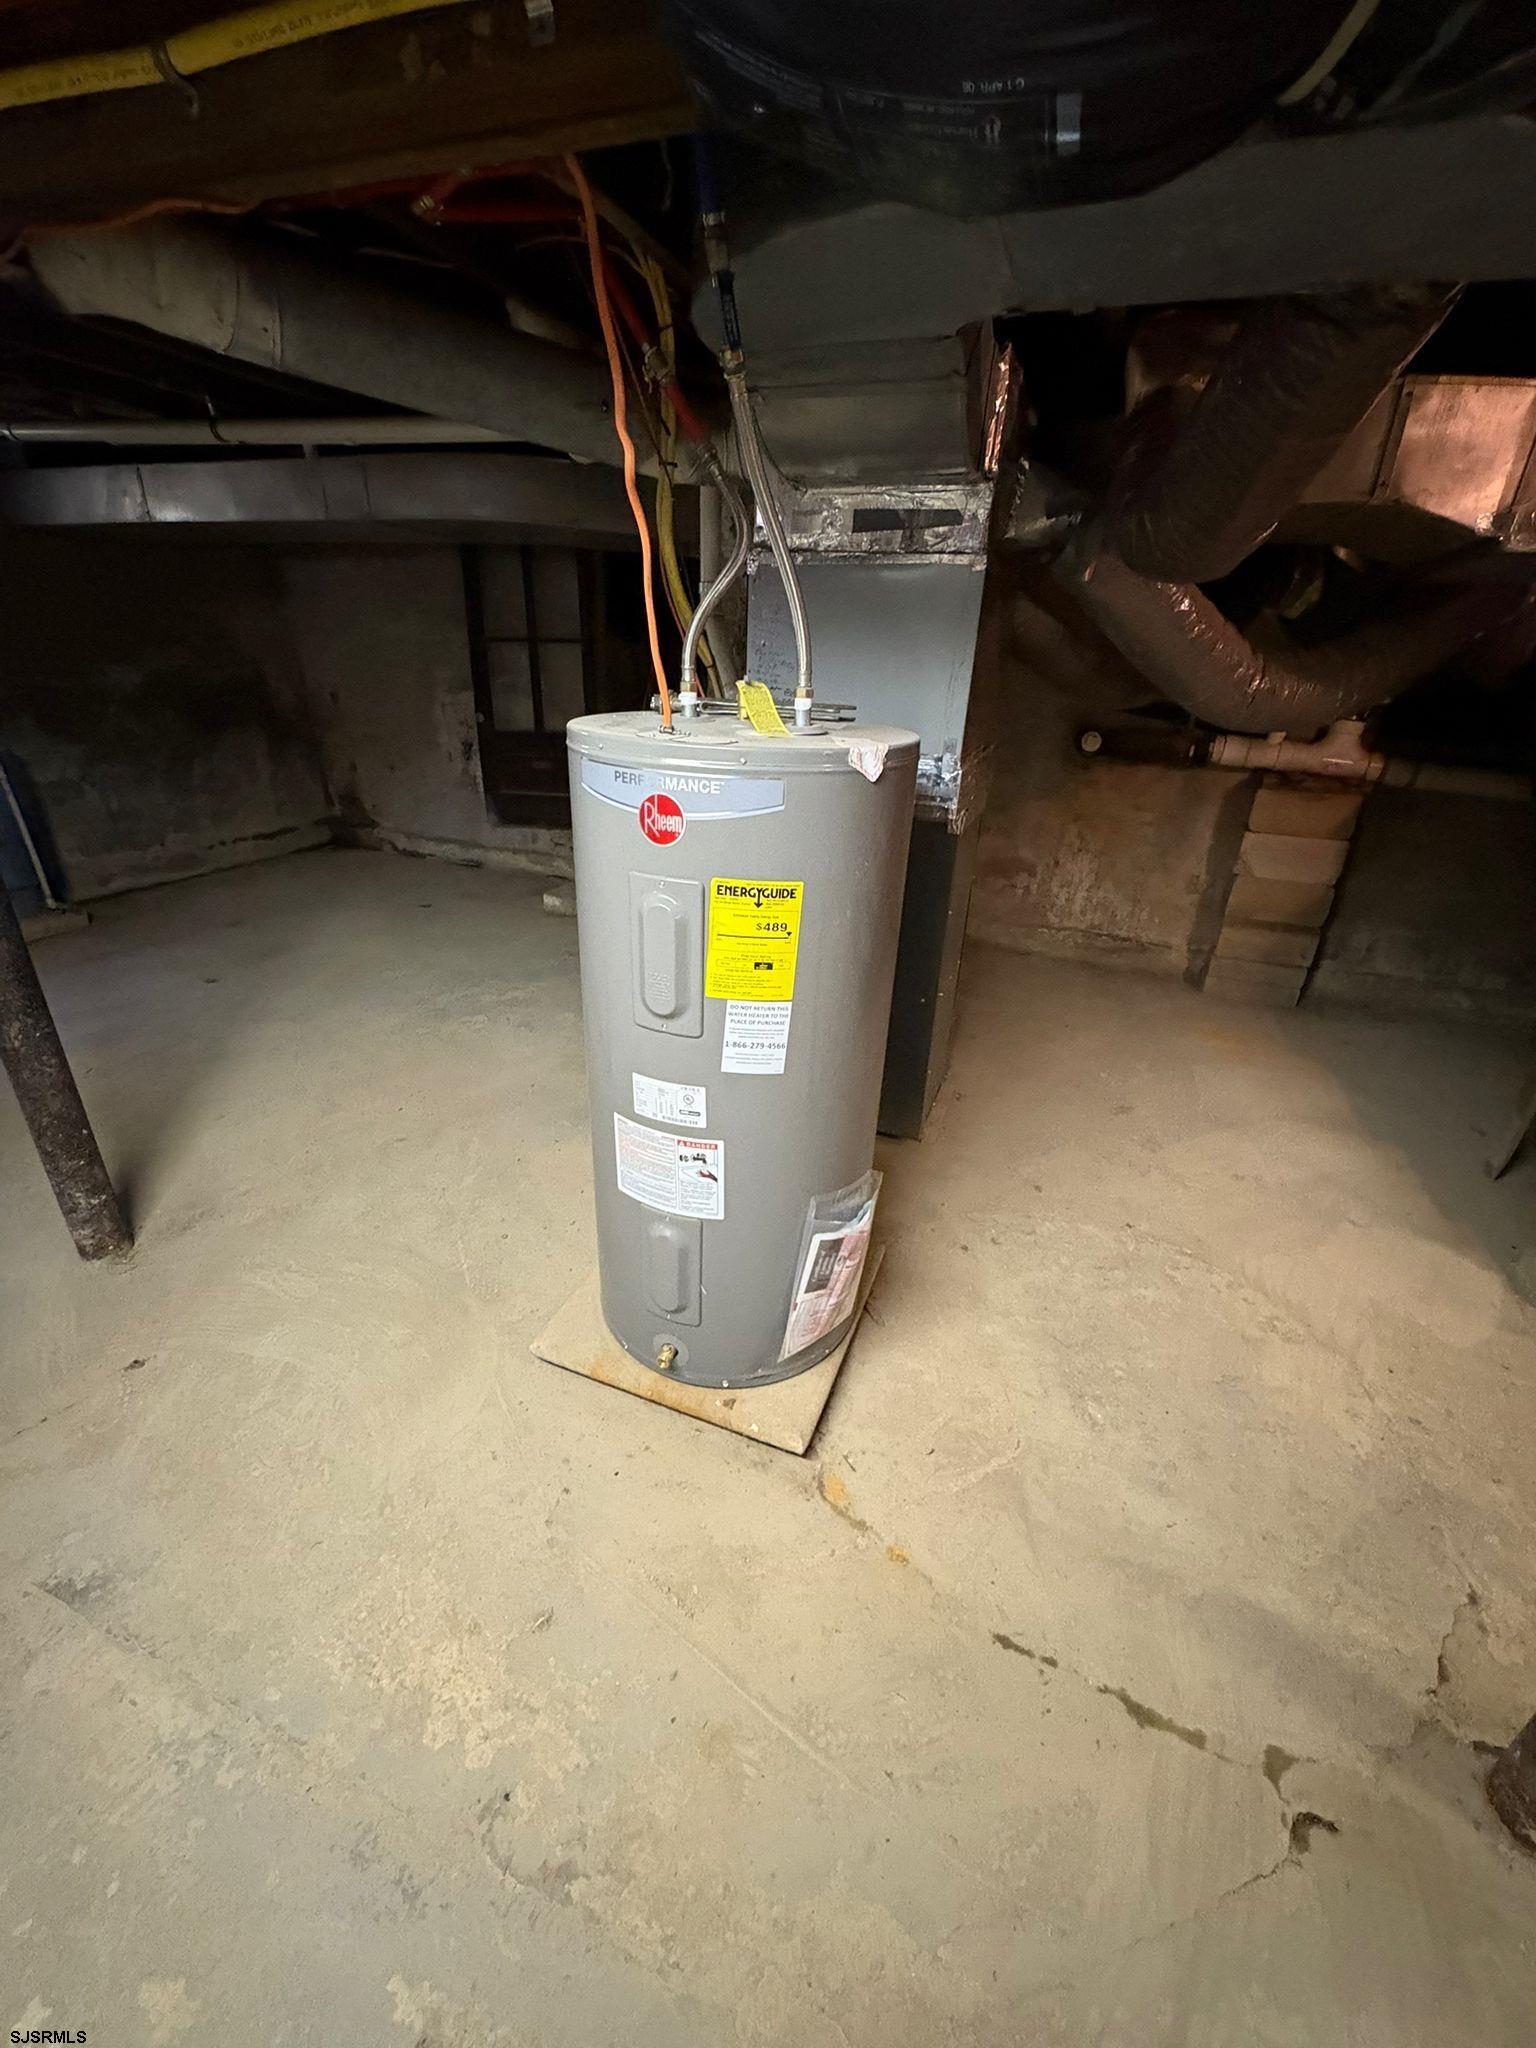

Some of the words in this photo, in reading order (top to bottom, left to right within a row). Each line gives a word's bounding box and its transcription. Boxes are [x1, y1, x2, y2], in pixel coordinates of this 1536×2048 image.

[614, 770, 721, 794] PERFRMANCE
[643, 794, 682, 838] Rheem
[716, 884, 798, 900] ENERGYGUIDE
[756, 922, 788, 932] $489
[725, 1040, 786, 1050] 1-866-279-4566
